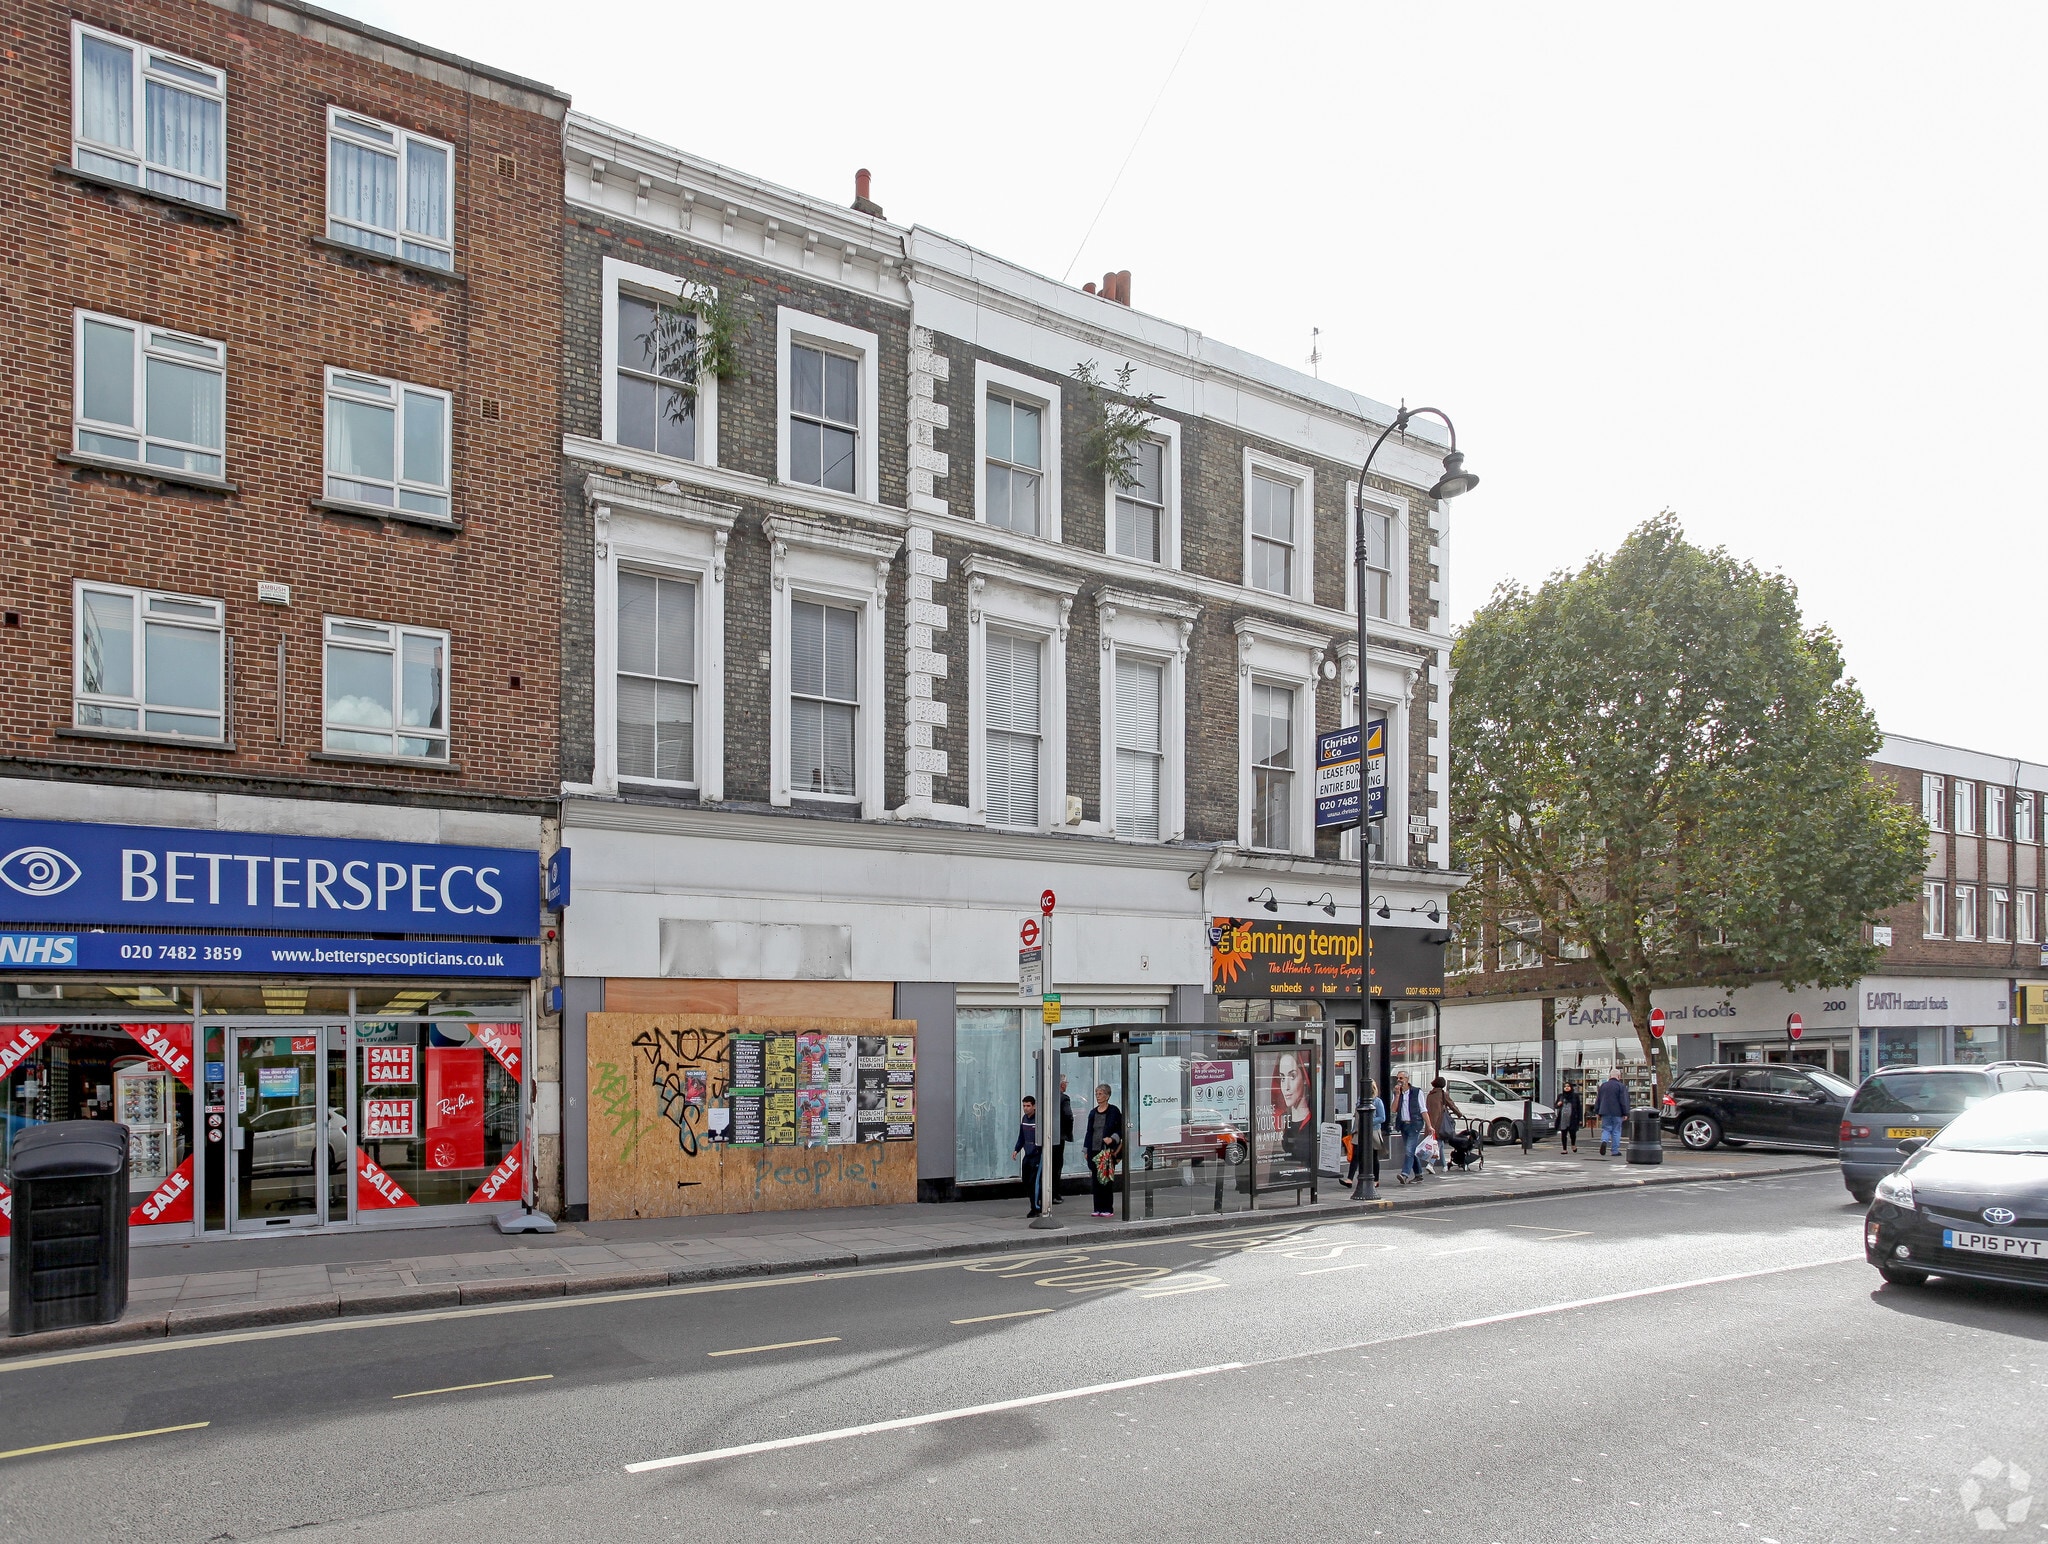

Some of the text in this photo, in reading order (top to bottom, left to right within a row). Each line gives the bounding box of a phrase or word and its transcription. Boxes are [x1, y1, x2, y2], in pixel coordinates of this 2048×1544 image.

[261, 584, 287, 593] AMBUSH
[1324, 734, 1358, 750] Christo
[1324, 749, 1342, 759] &Co
[1322, 759, 1380, 780] LEASE FOR ALE
[1320, 780, 1344, 795] ENTIRE
[1320, 801, 1336, 811] 020
[1337, 796, 1358, 808] 7482
[122, 849, 503, 915] BETTERSPECS
[1041, 896, 1053, 907] KC
[0, 936, 75, 964] NHS
[1230, 923, 1306, 964] tanning
[120, 945, 242, 960] 020 7482 3859
[271, 948, 505, 966] www.betterspecsopticians.co.uk
[1268, 962, 1281, 973] The
[1281, 960, 1312, 975] Ultimate
[1313, 963, 1339, 978] Tanning
[1214, 984, 1226, 993] 204
[1270, 982, 1302, 993] sunbeds
[1322, 982, 1338, 993] hair
[1405, 986, 1441, 995] 0207 485 5599
[1823, 1000, 1847, 1012] 200
[1867, 991, 1949, 1011] EARTH natural foods
[1568, 1007, 1631, 1026] EARTH
[1692, 1003, 1737, 1019] foods
[1071, 1027, 1090, 1035] JCDecaux
[140, 1028, 190, 1073] SALE
[371, 1049, 410, 1063] SALE
[478, 1027, 519, 1070] SALE
[371, 1065, 410, 1080] SALE
[435, 1093, 474, 1115] Ray-Ban
[1153, 1096, 1178, 1104] Camden
[370, 1102, 410, 1117] SALE
[1255, 1104, 1276, 1115] CHANGE
[370, 1119, 410, 1134] SALE
[1256, 1114, 1292, 1131] YOUR LIFE
[1256, 1131, 1284, 1142] IN AN HOUR
[1892, 1128, 1917, 1138] YY59
[360, 1163, 404, 1205] SALE
[481, 1155, 520, 1200] SALE
[142, 1172, 190, 1221] SALE
[1959, 1234, 2042, 1255] LP15 PYT
